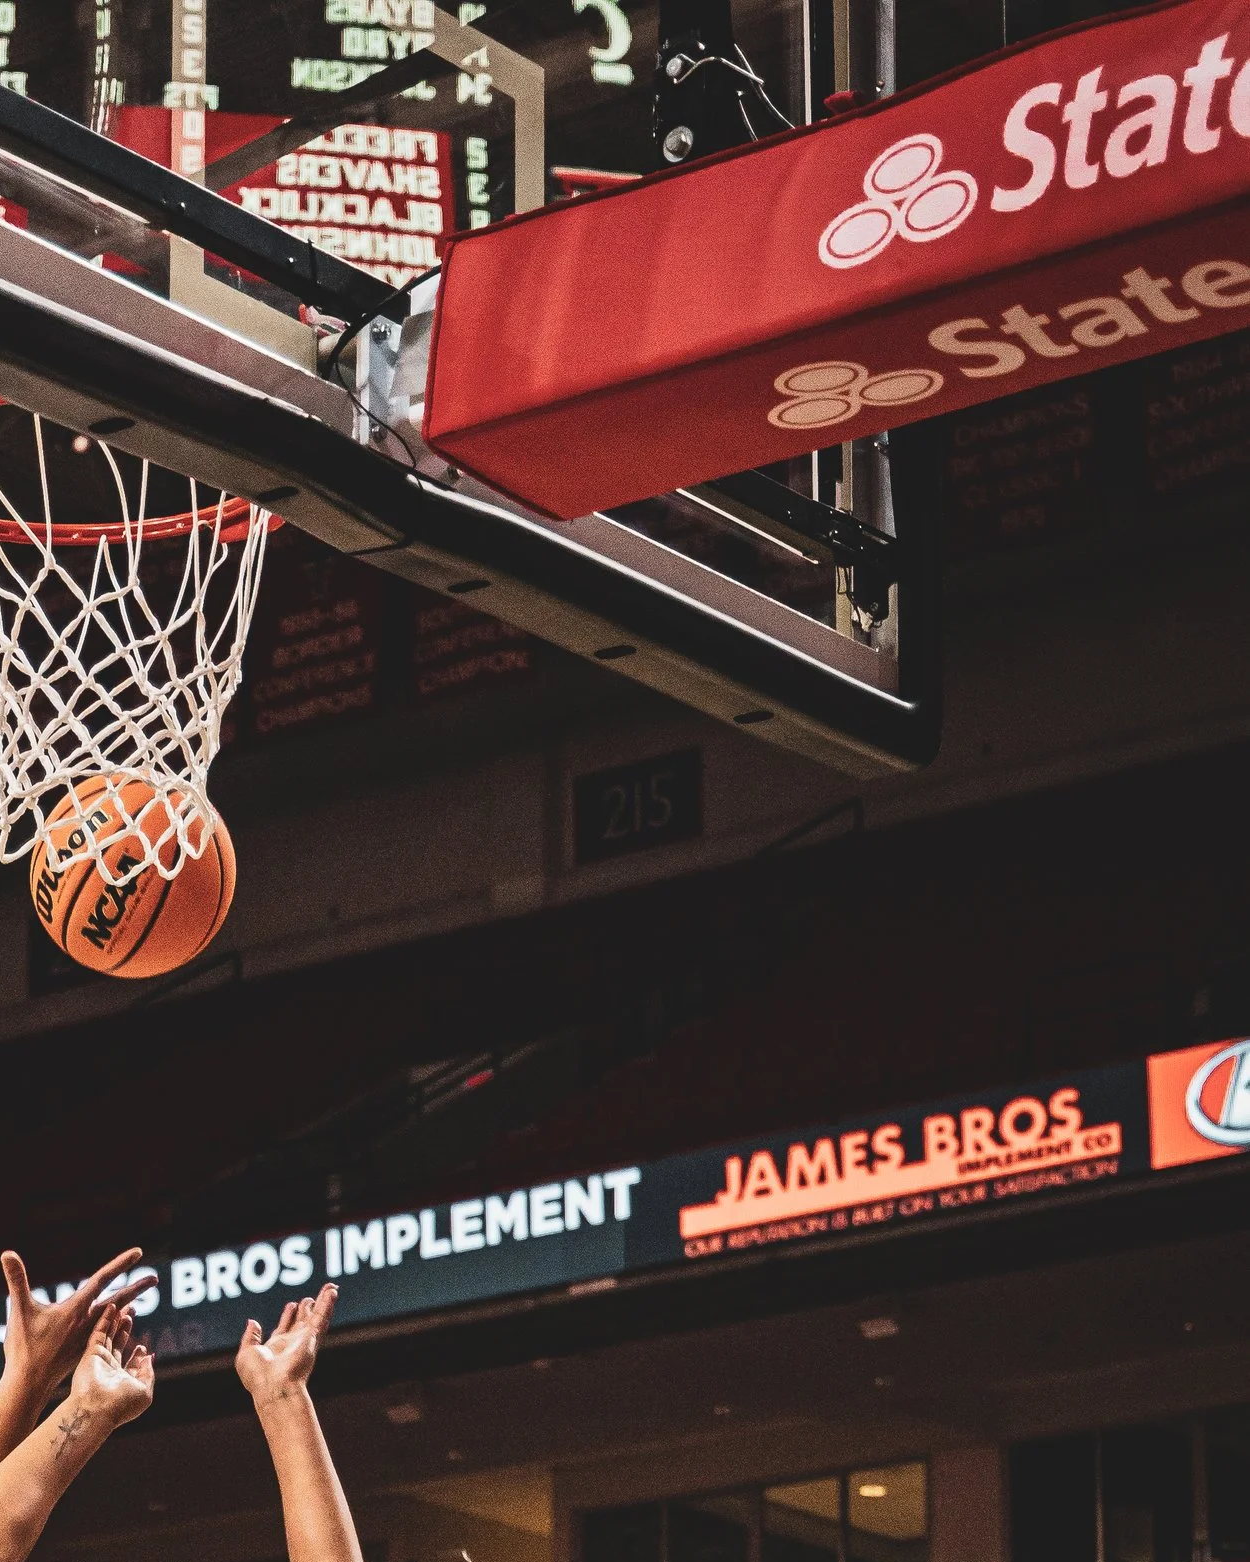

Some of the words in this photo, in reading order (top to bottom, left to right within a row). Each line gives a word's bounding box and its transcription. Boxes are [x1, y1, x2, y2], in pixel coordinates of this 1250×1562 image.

[81, 852, 142, 949] NCAA
[713, 1121, 906, 1205] JAMES
[923, 1087, 1081, 1160] BROS
[1082, 1132, 1113, 1151] CO
[171, 1232, 314, 1309] BROS
[325, 1166, 642, 1279] IMPLEMENT
